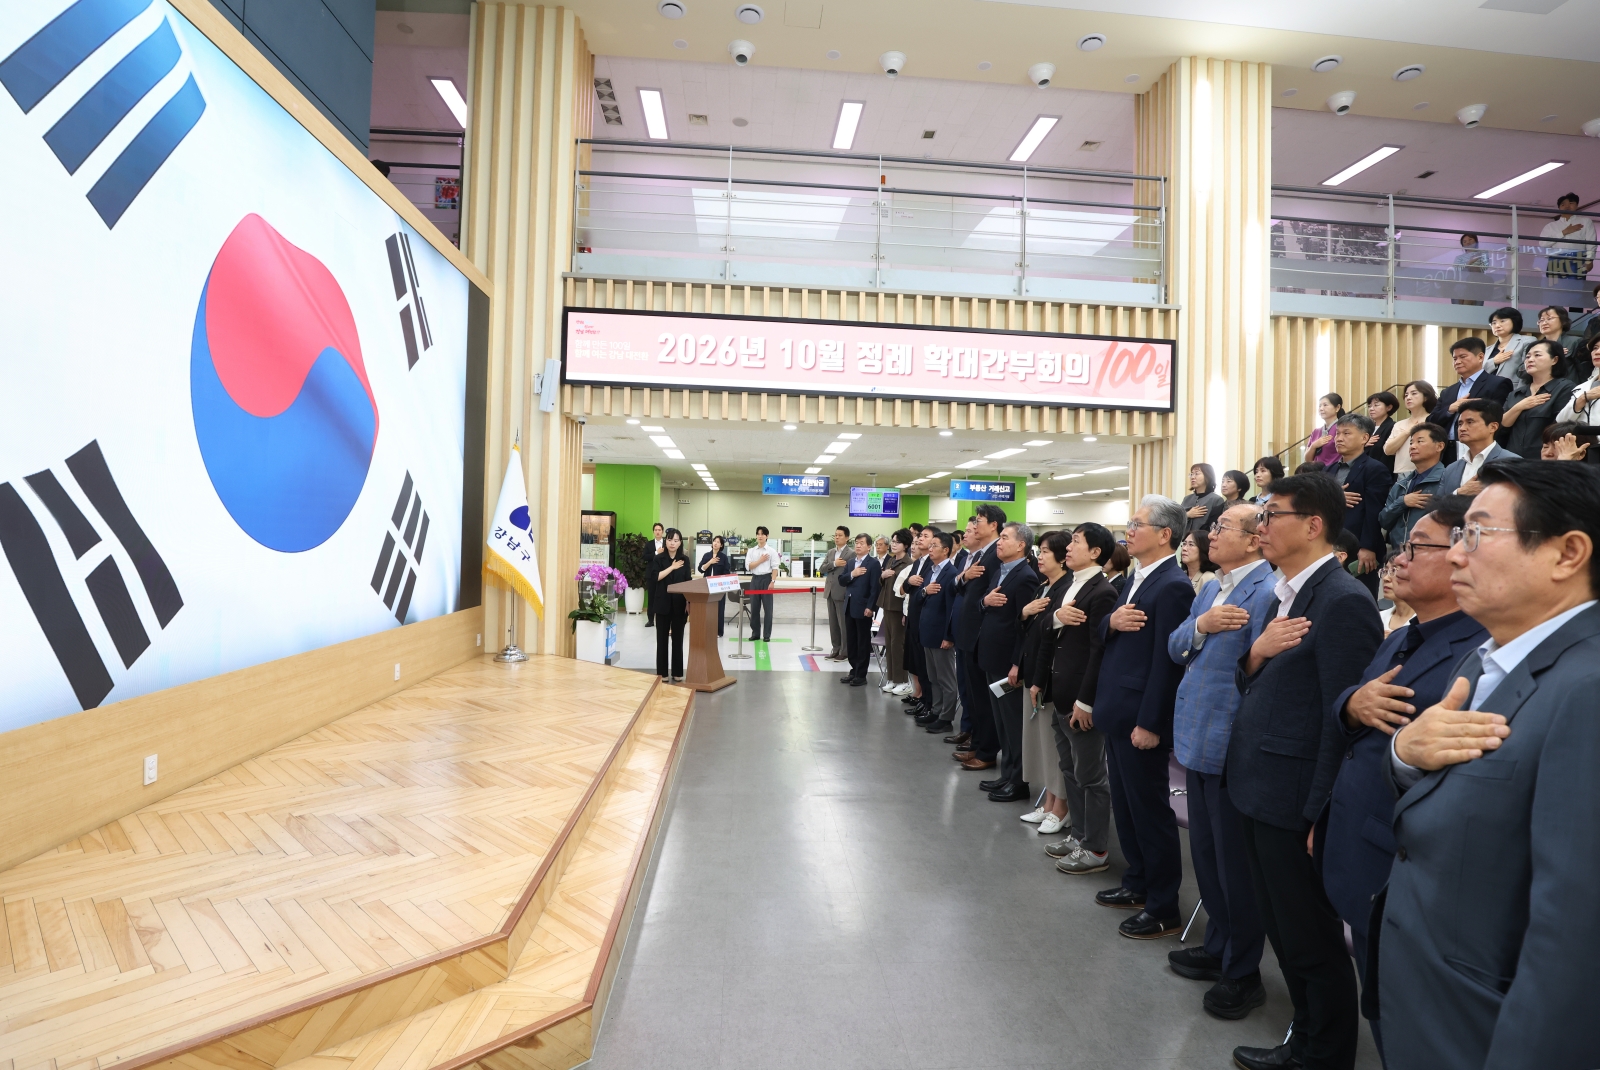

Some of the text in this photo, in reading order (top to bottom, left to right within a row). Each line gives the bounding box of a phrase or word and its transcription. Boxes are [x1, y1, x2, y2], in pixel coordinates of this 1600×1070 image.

[575, 339, 631, 350] 함께 만든 100일
[575, 349, 590, 358] 함께
[609, 351, 625, 360] 강남
[657, 332, 1090, 384] 2026년 10월 정례 확대간부회의
[1093, 340, 1171, 397] 100일
[782, 478, 800, 487] 부동산
[969, 484, 1011, 493] 부동산 거래신고
[494, 525, 531, 563] 강남구
